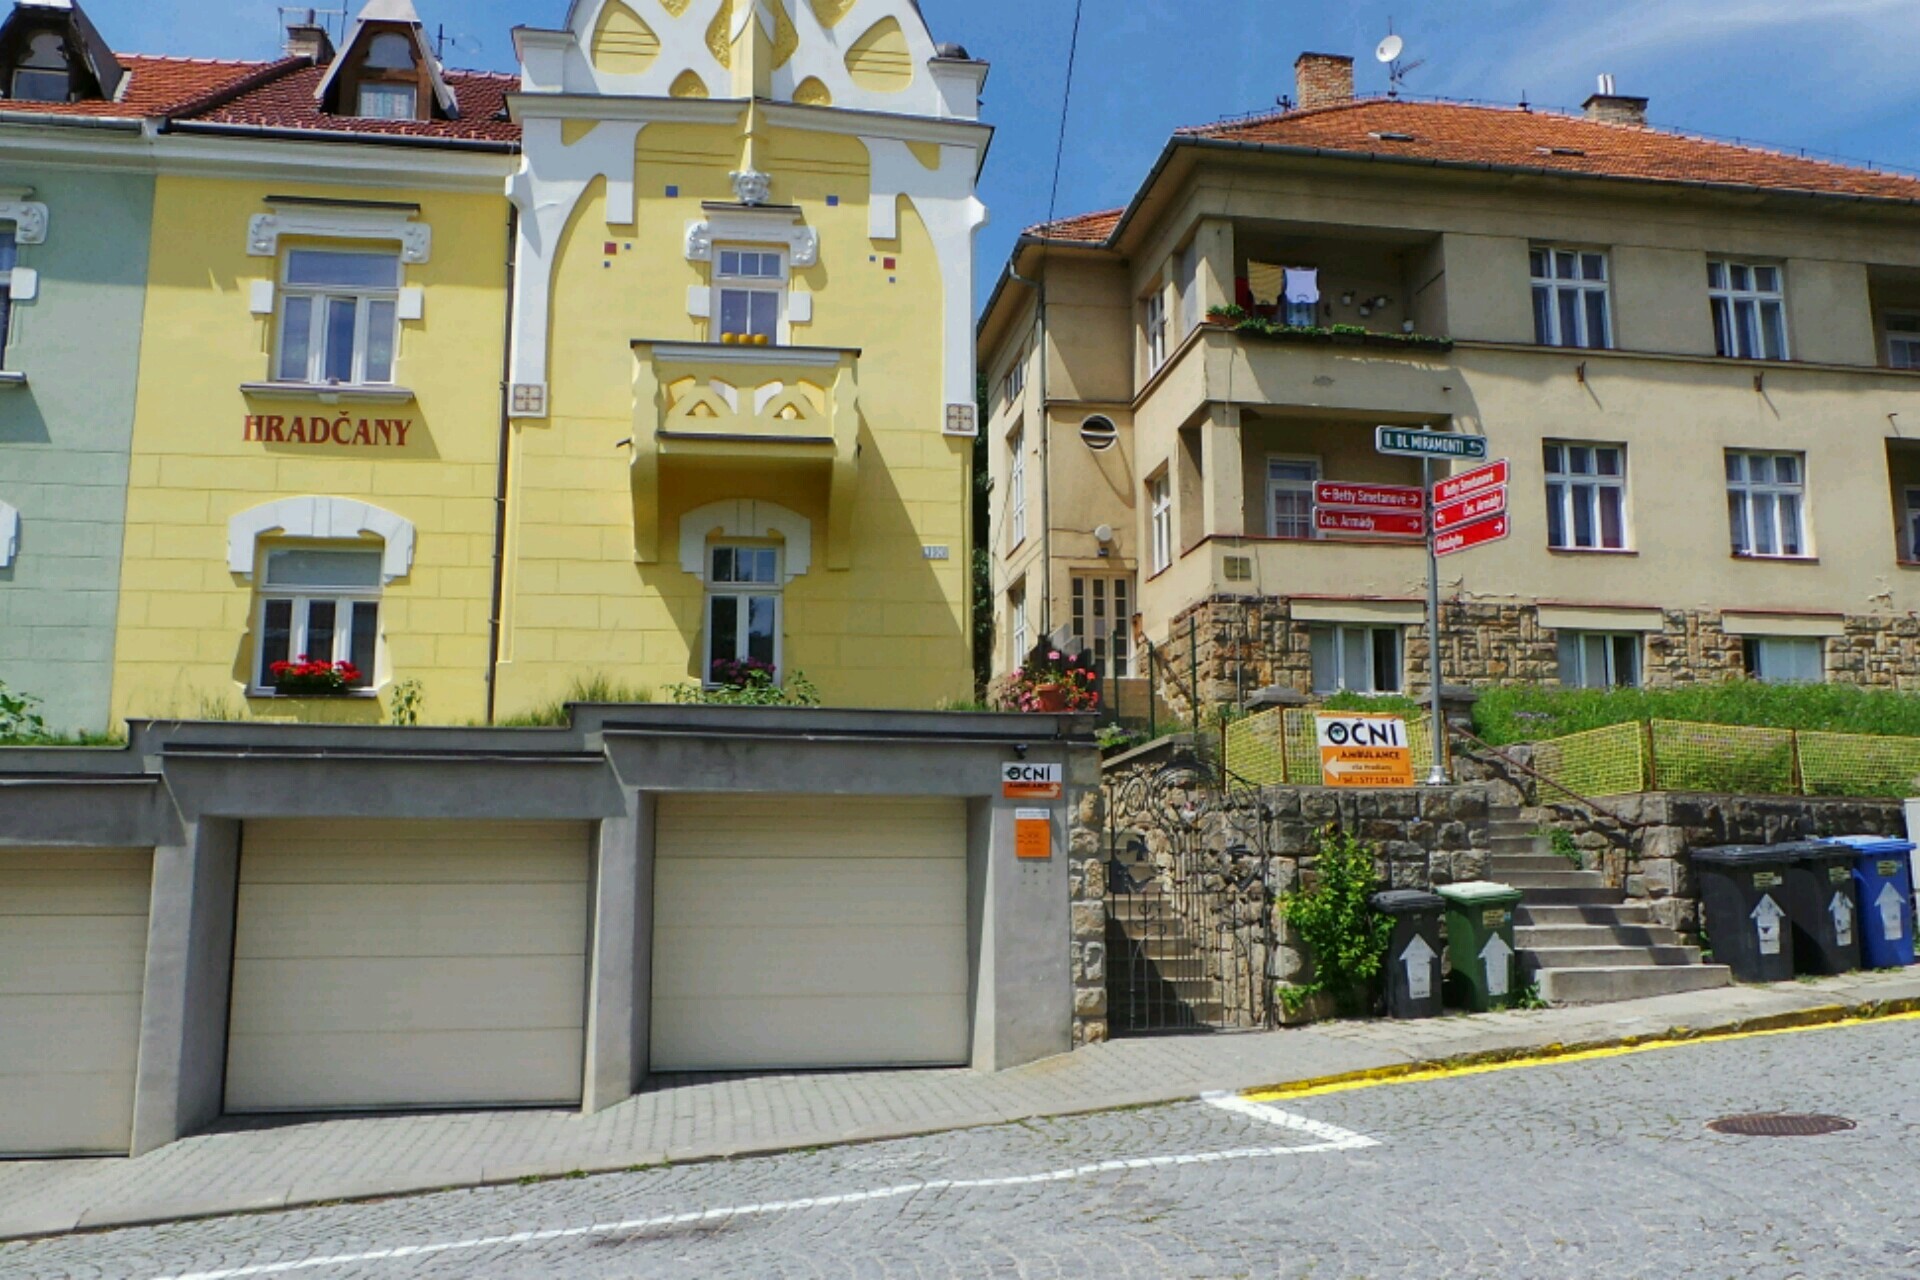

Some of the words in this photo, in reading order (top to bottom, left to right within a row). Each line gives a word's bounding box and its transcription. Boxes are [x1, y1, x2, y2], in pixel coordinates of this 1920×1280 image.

[243, 411, 412, 446] HRADČANY
[1411, 435, 1464, 454] MIRAMONTI
[1332, 488, 1356, 504] Betty
[1358, 490, 1406, 505] Smetanové
[1326, 718, 1398, 746] OČNÍ
[1007, 765, 1050, 781] OČNÍ
